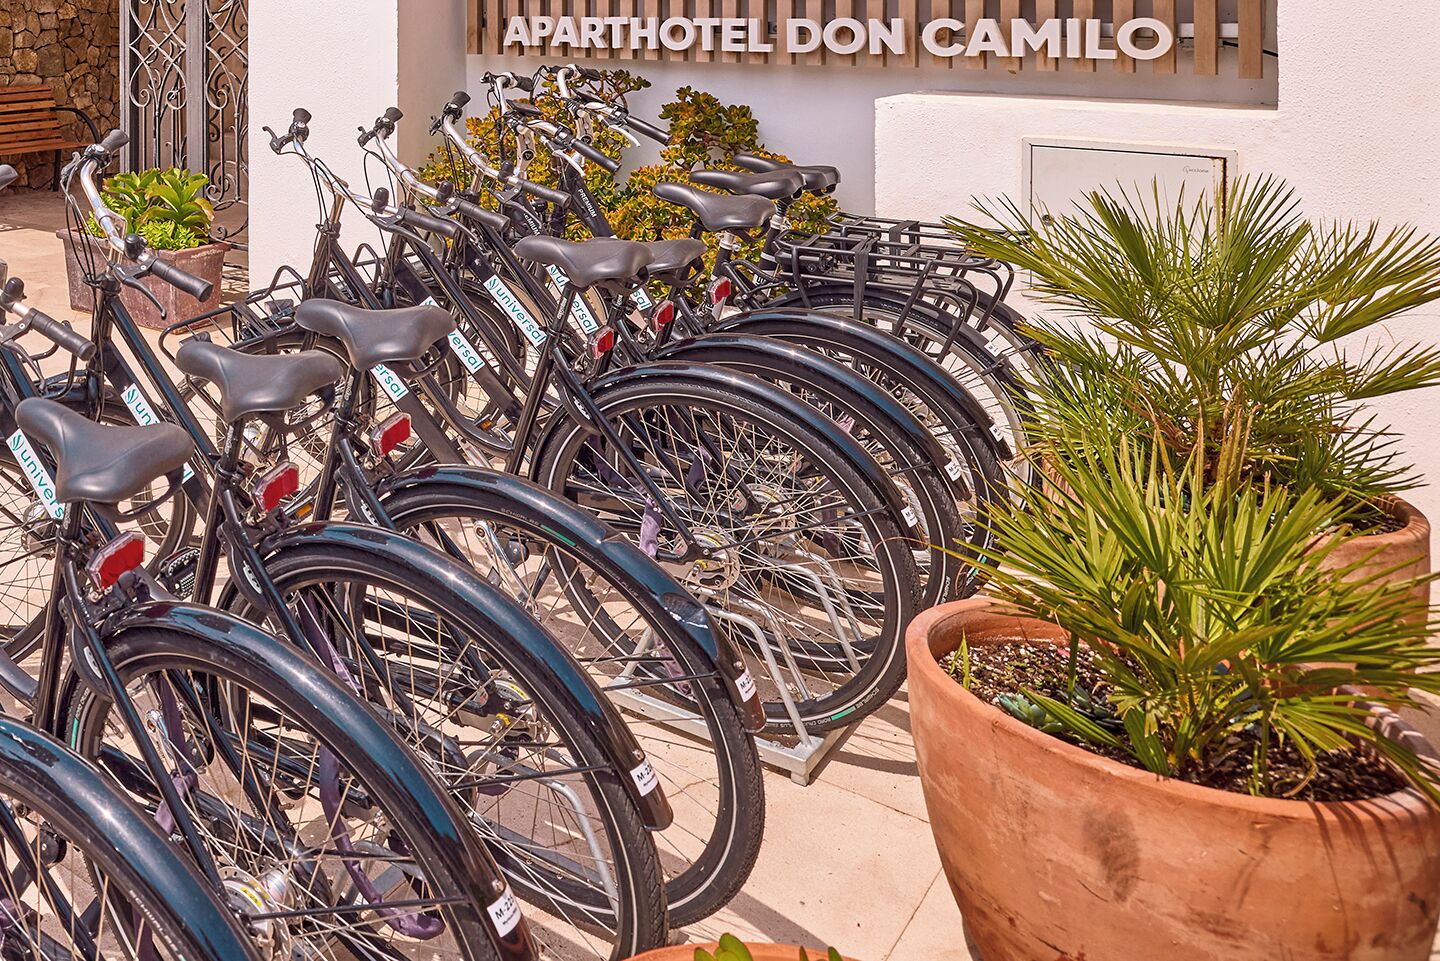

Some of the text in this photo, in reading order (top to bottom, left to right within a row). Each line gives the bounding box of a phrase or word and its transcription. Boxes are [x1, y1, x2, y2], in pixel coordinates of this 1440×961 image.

[504, 15, 1175, 61] APARTHOTEL DON CAMILO
[496, 288, 547, 343] universal
[20, 449, 64, 517] univers
